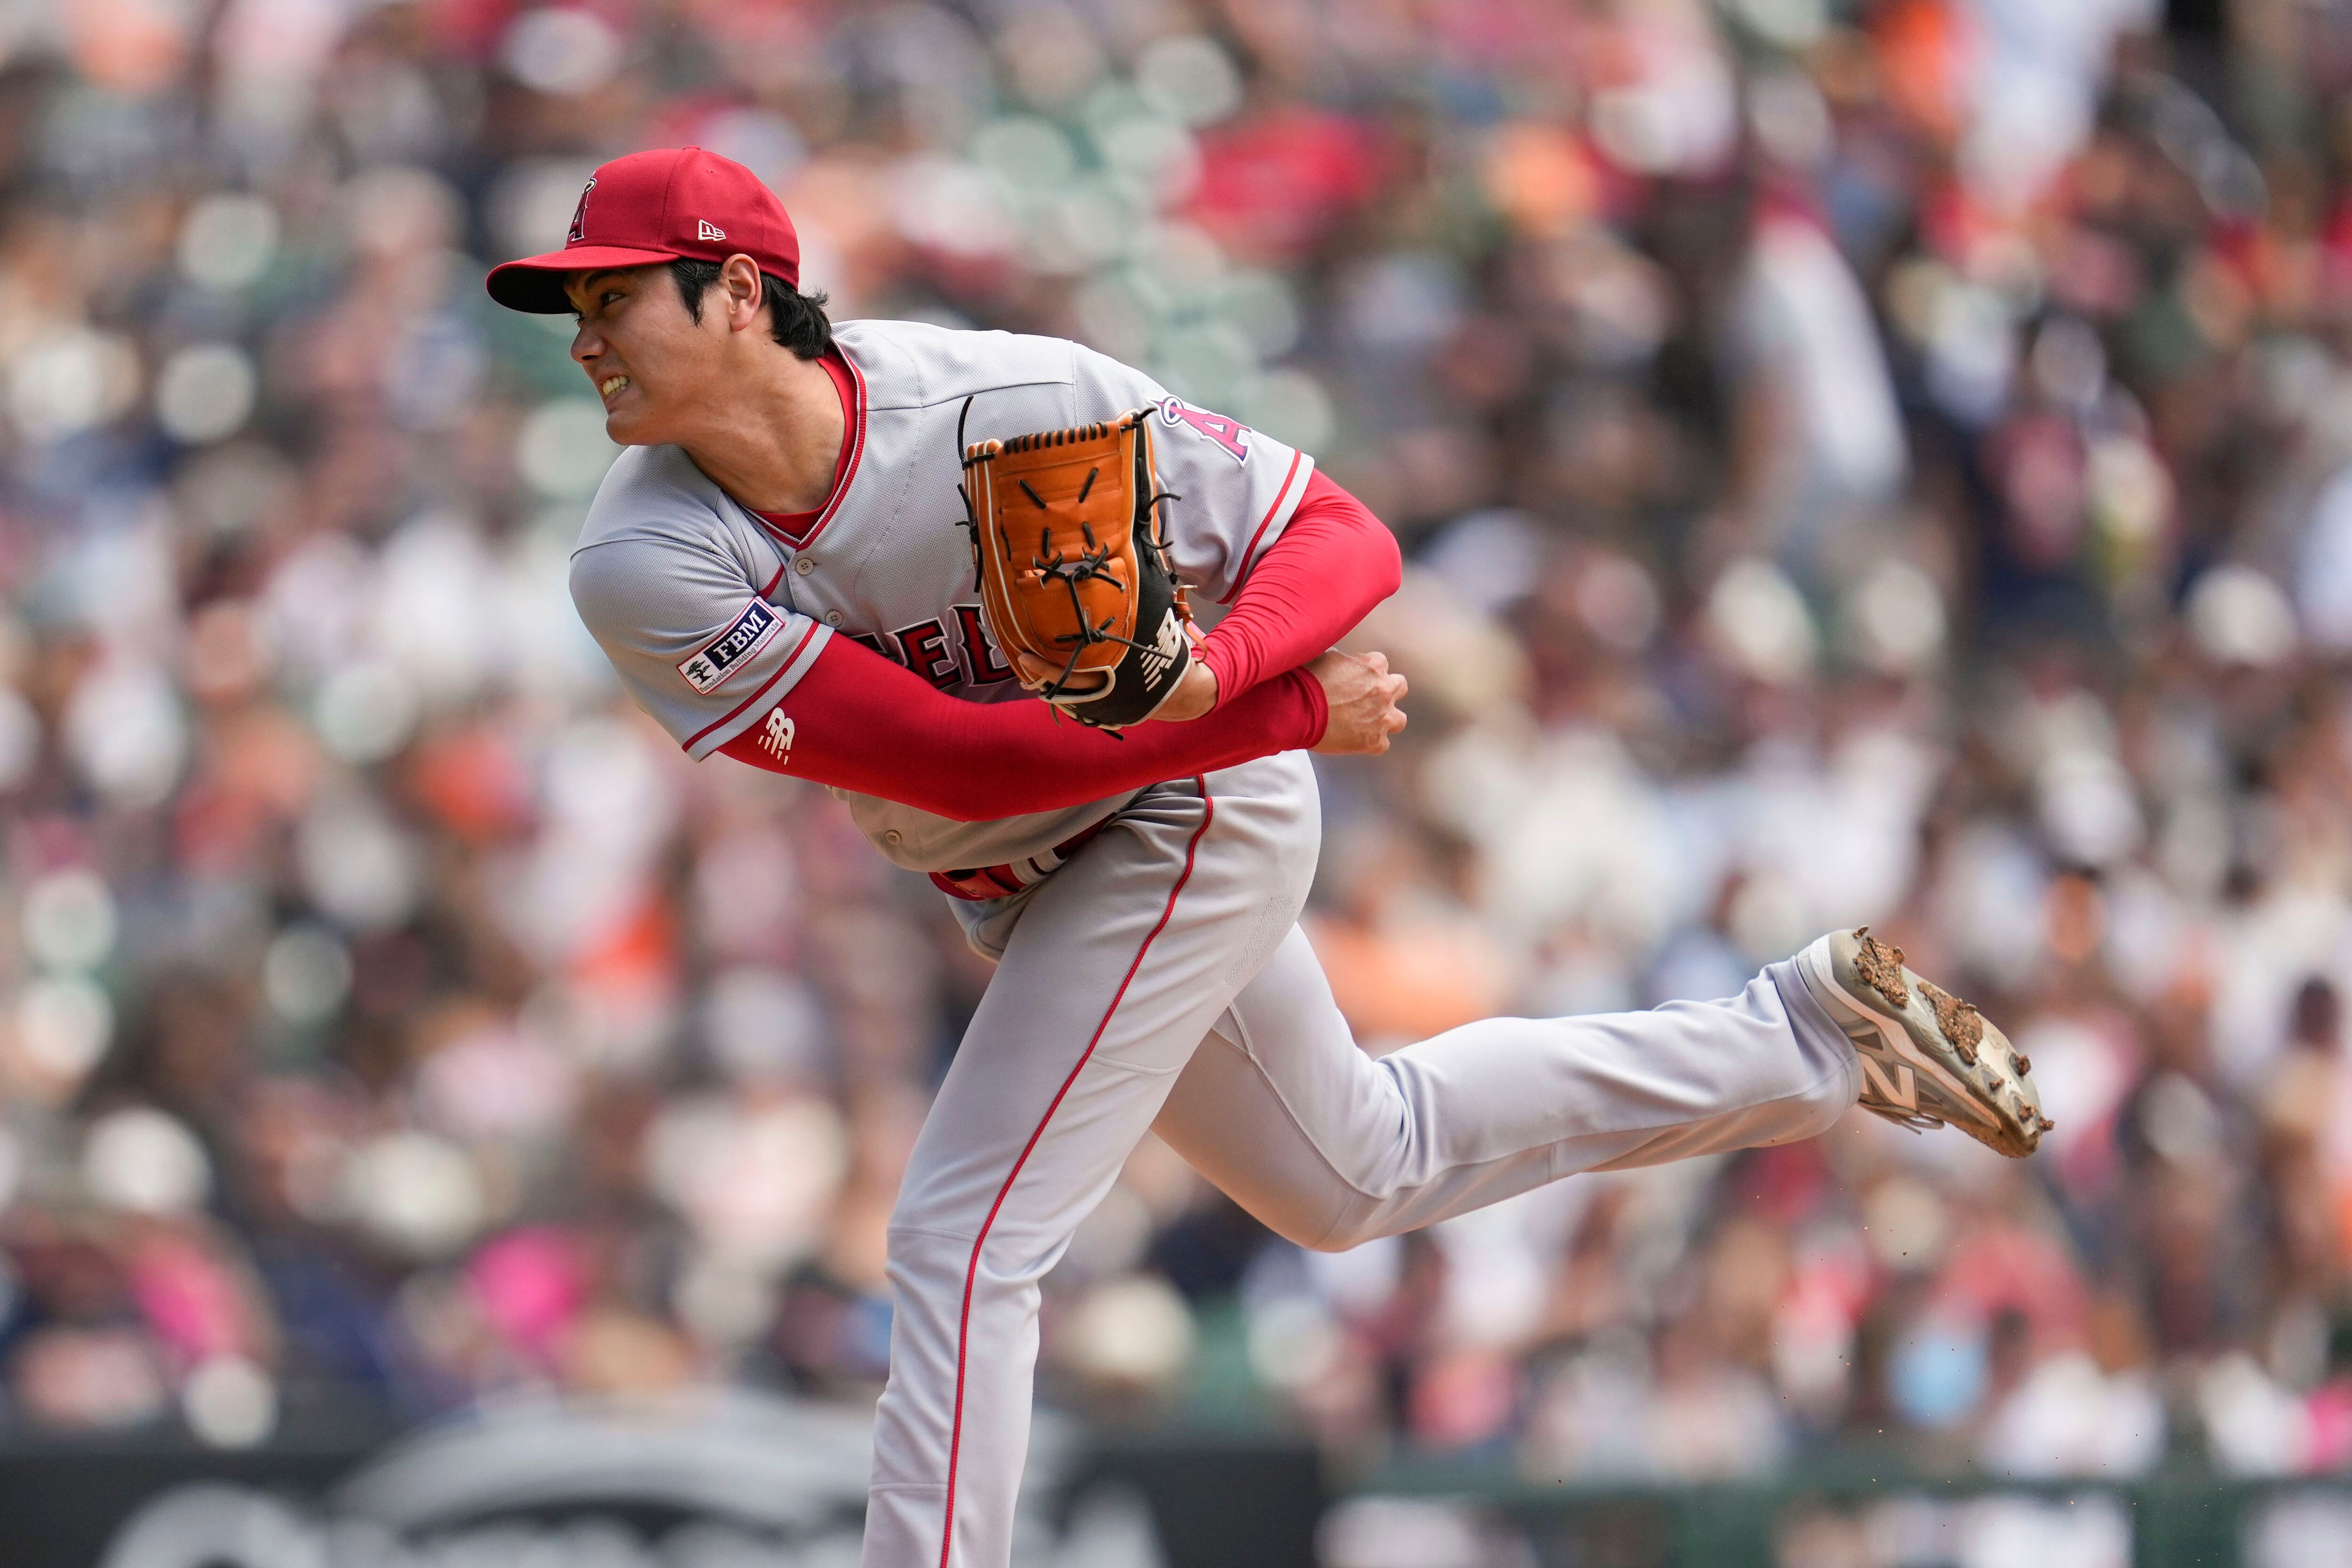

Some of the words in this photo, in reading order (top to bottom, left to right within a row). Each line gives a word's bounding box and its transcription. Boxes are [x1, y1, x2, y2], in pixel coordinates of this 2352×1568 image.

[699, 669, 731, 692] Foundation
[730, 647, 756, 671] Building
[755, 621, 780, 648] Materials
[713, 610, 767, 663] FBM
[848, 604, 1016, 691] EL
